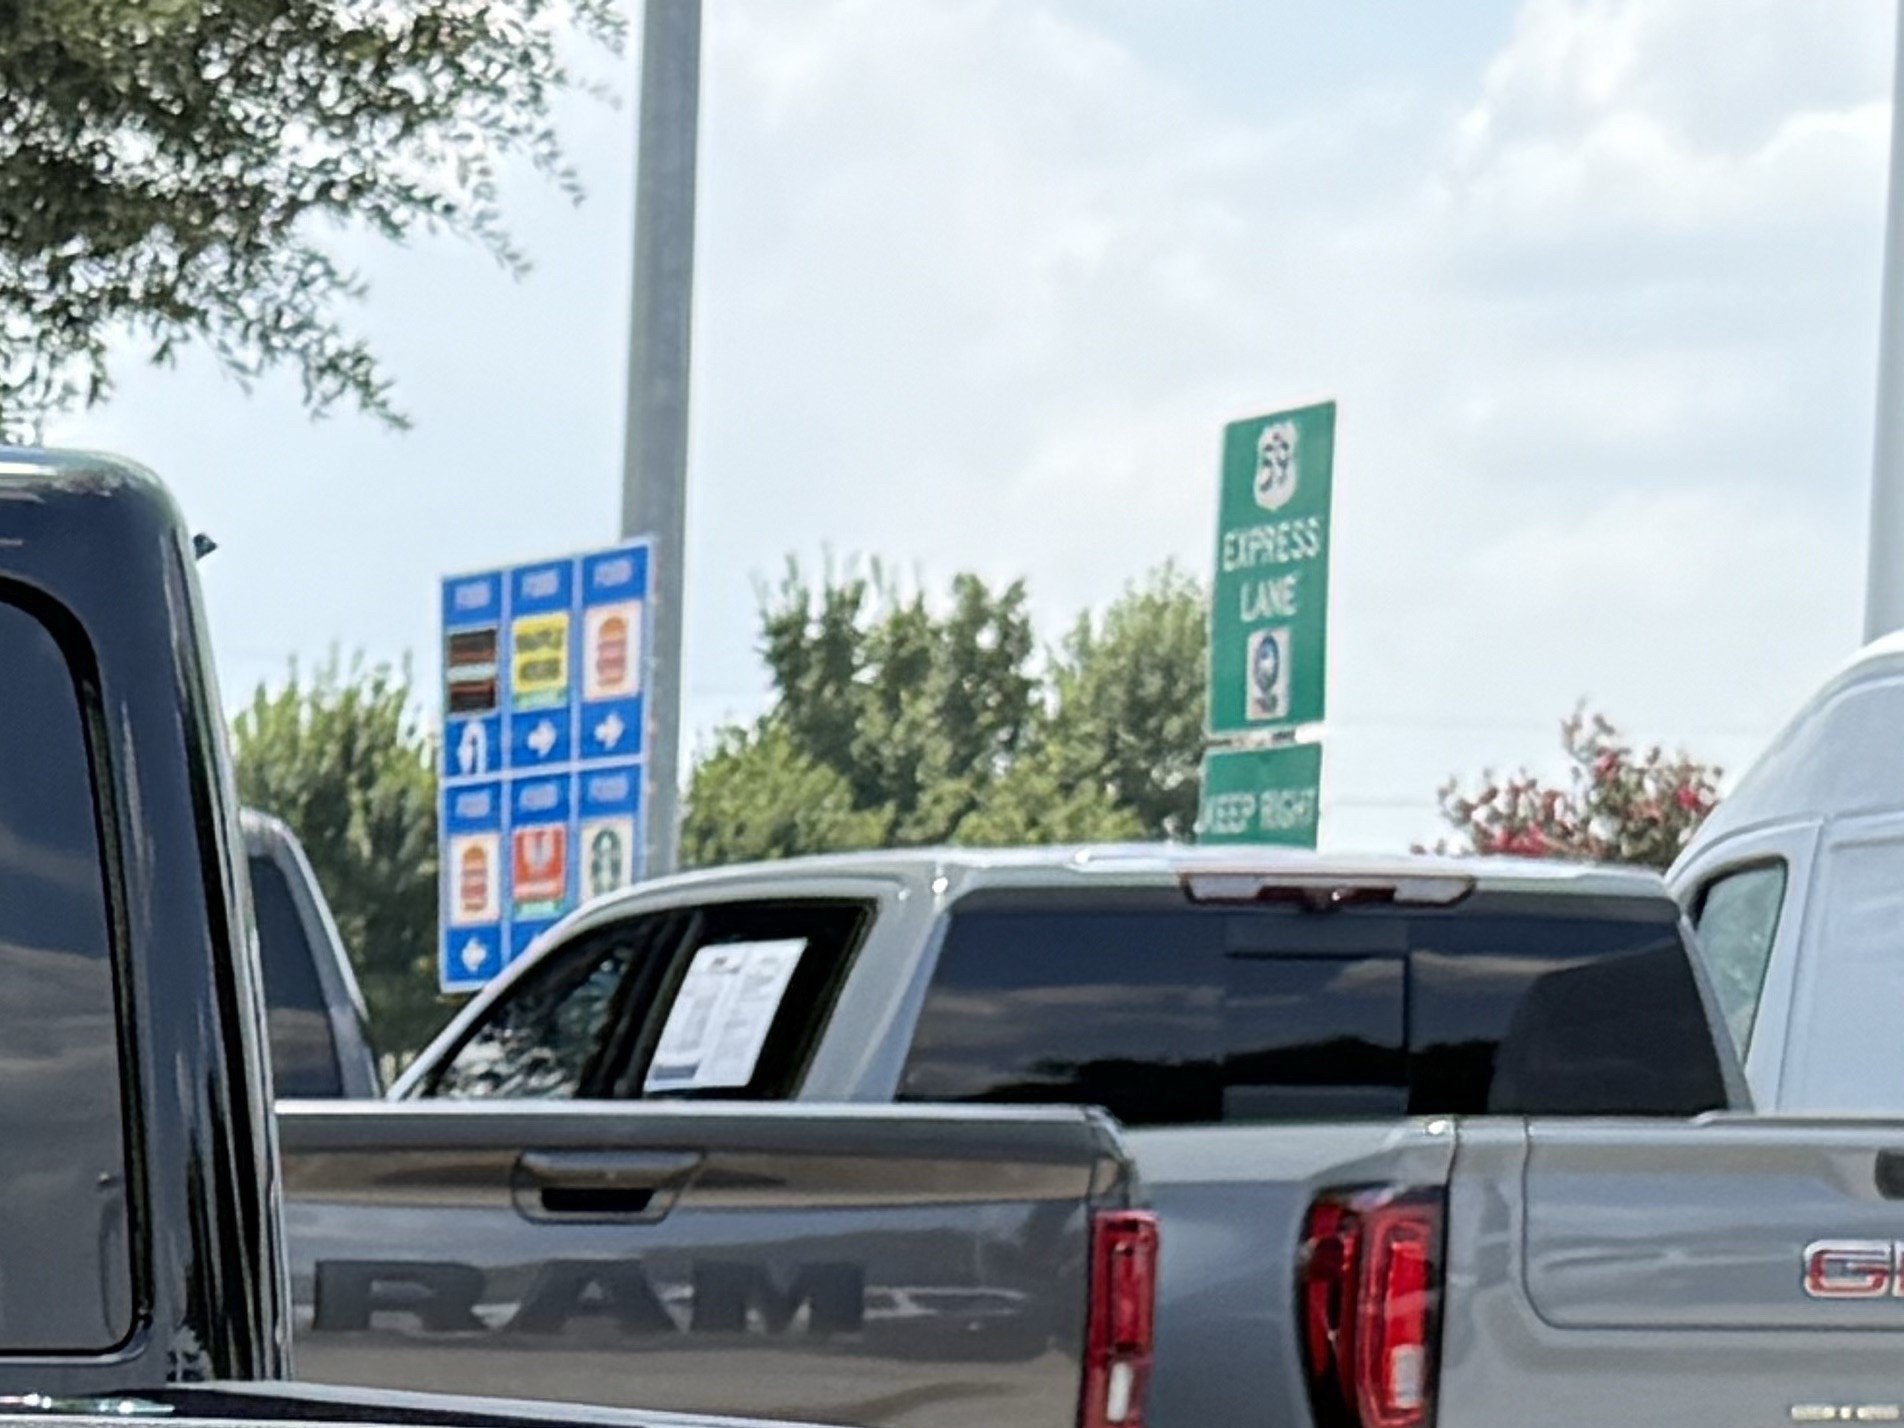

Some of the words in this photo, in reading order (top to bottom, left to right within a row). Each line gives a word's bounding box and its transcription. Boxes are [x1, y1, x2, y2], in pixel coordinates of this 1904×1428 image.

[1223, 517, 1320, 571] EXPRESS
[1240, 574, 1298, 622] LANE
[312, 1259, 865, 1335] RAM
